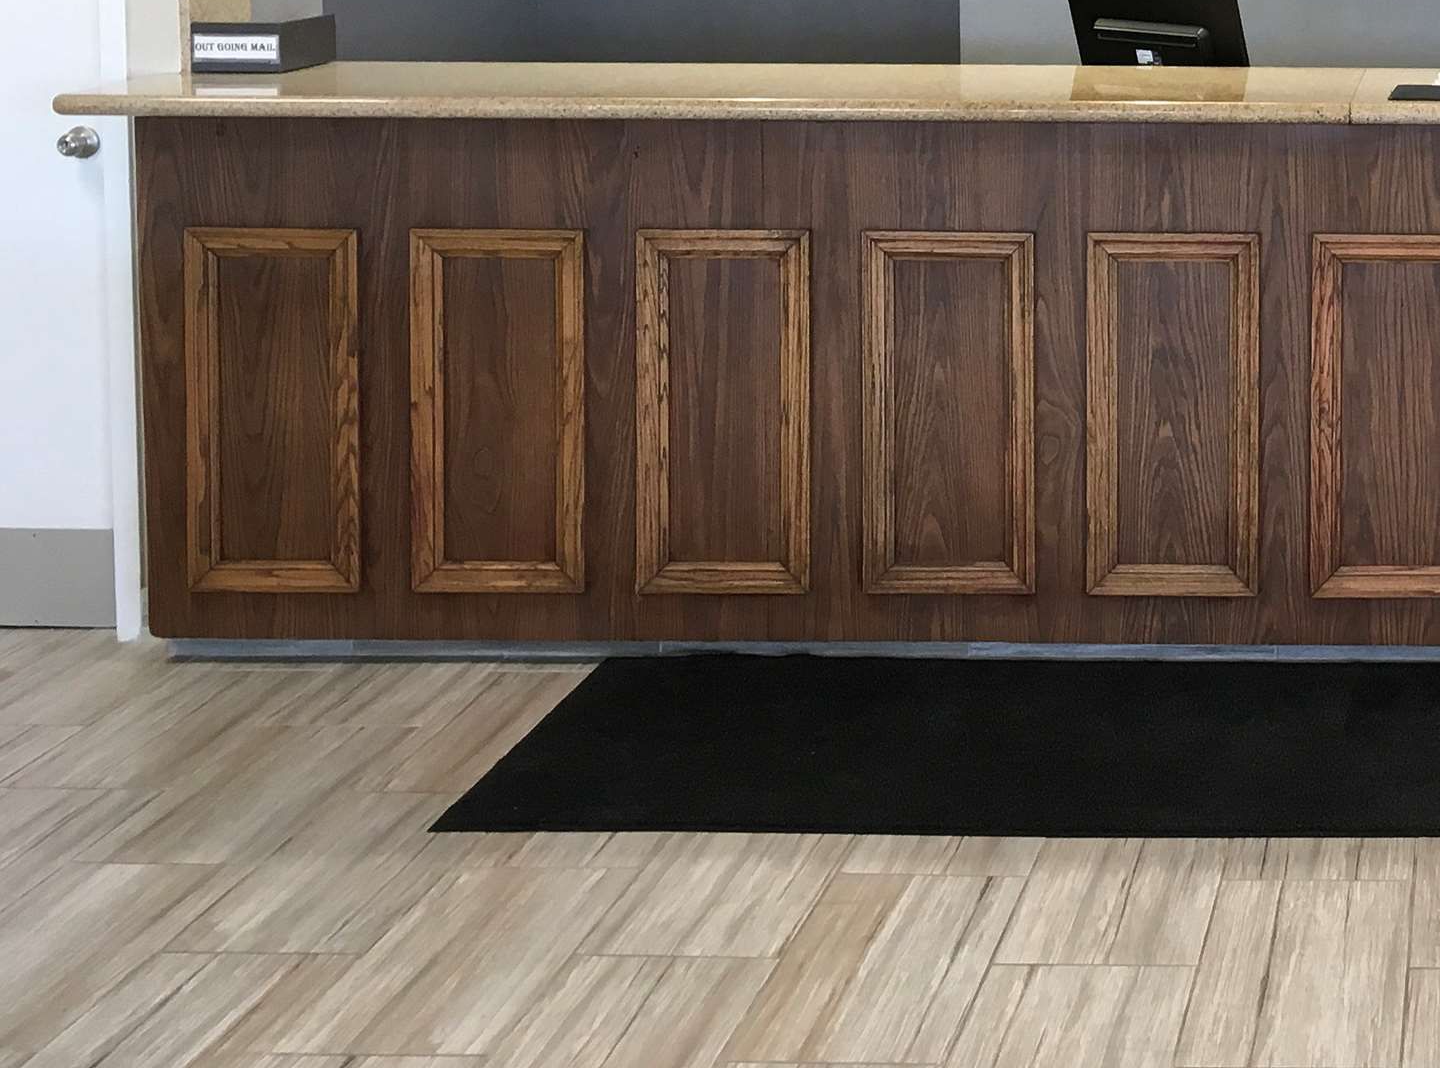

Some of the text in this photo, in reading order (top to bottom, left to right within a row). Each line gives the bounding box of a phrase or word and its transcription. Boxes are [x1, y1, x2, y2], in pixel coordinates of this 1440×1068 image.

[195, 42, 275, 52] OUT GOING MAIL
